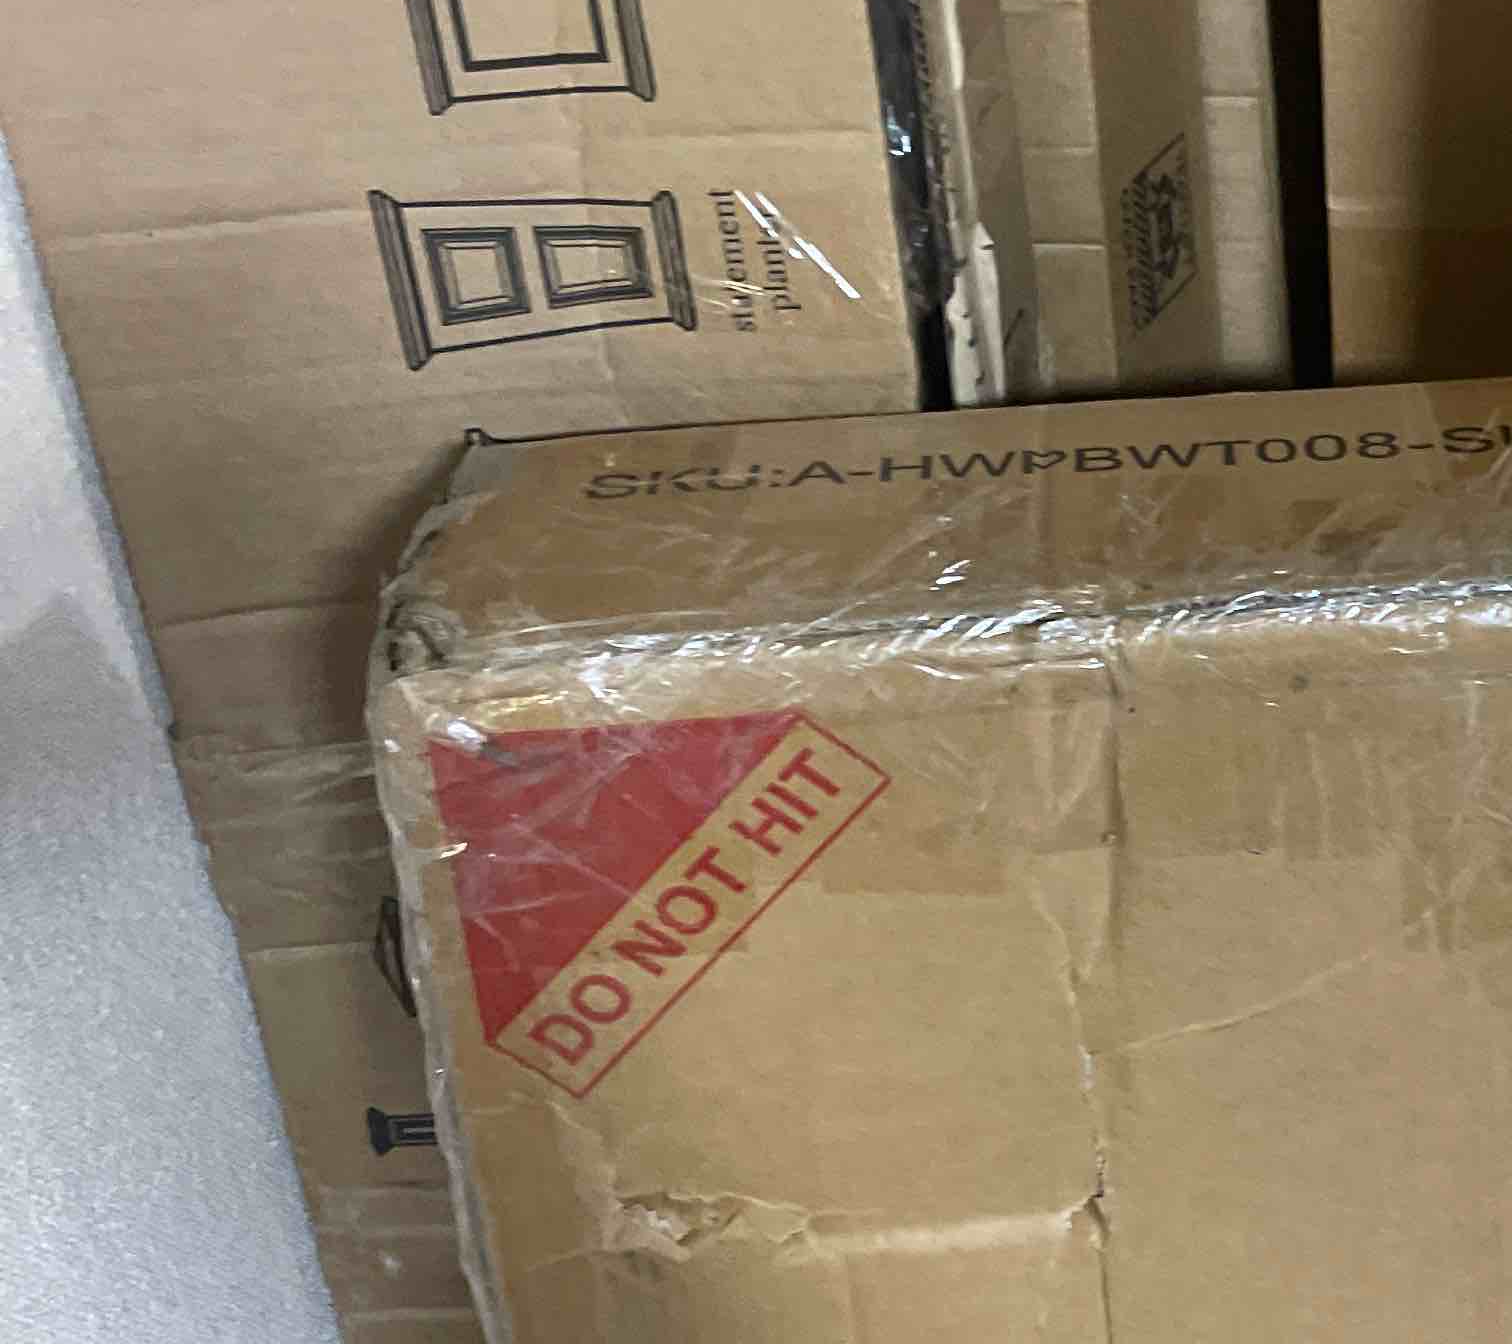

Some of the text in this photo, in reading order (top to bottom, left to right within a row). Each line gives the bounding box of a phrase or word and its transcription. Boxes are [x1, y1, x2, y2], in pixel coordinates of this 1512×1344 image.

[528, 746, 841, 1067] DO NOT HIT
